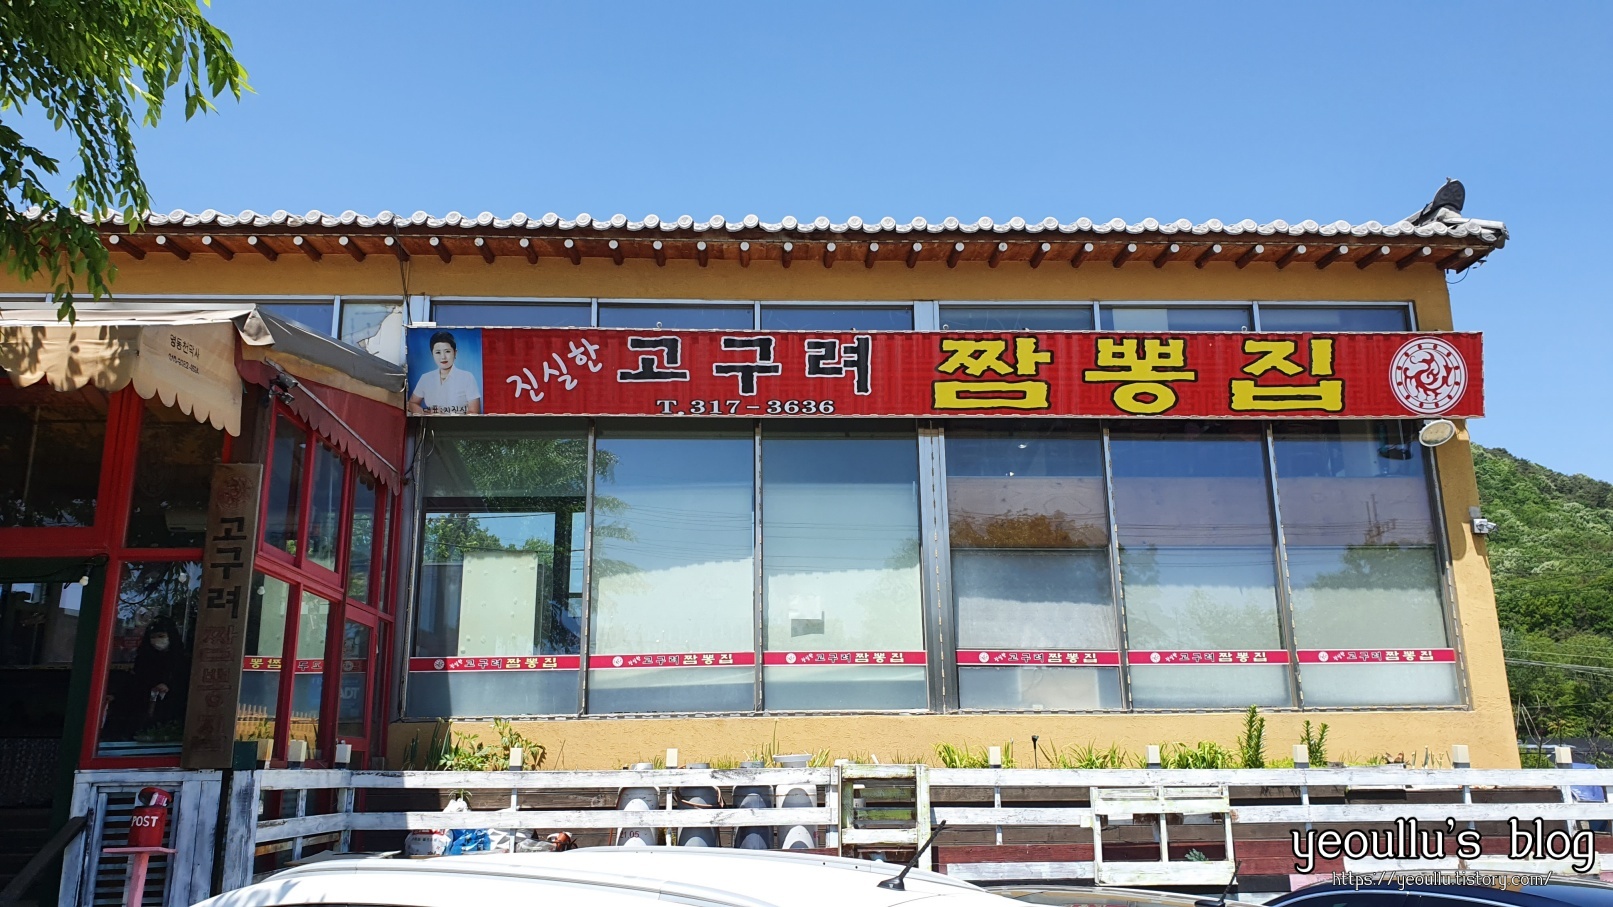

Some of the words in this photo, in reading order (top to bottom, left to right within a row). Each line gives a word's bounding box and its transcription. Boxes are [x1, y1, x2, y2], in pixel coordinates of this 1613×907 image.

[506, 338, 602, 402] 진실한
[617, 335, 872, 396] 고구려
[931, 336, 1346, 414] 짬뽕집
[207, 516, 247, 619] 고구려
[642, 655, 680, 666] 고구려
[683, 653, 733, 665] 짬뽕집
[815, 653, 852, 663] 고구려
[855, 652, 904, 663] 짬뽕집
[1008, 652, 1044, 663] 고구려
[1048, 652, 1098, 663] 짬뽕집
[1179, 652, 1215, 663] 고구려
[1219, 652, 1268, 662] 짬뽕집
[1347, 651, 1382, 662] 고구려
[1385, 650, 1434, 661] 짬뽕집
[464, 658, 502, 669] 고구려
[505, 657, 558, 668] 짬뽕집
[190, 625, 238, 750] 짬뽕집
[131, 815, 159, 828] POST
